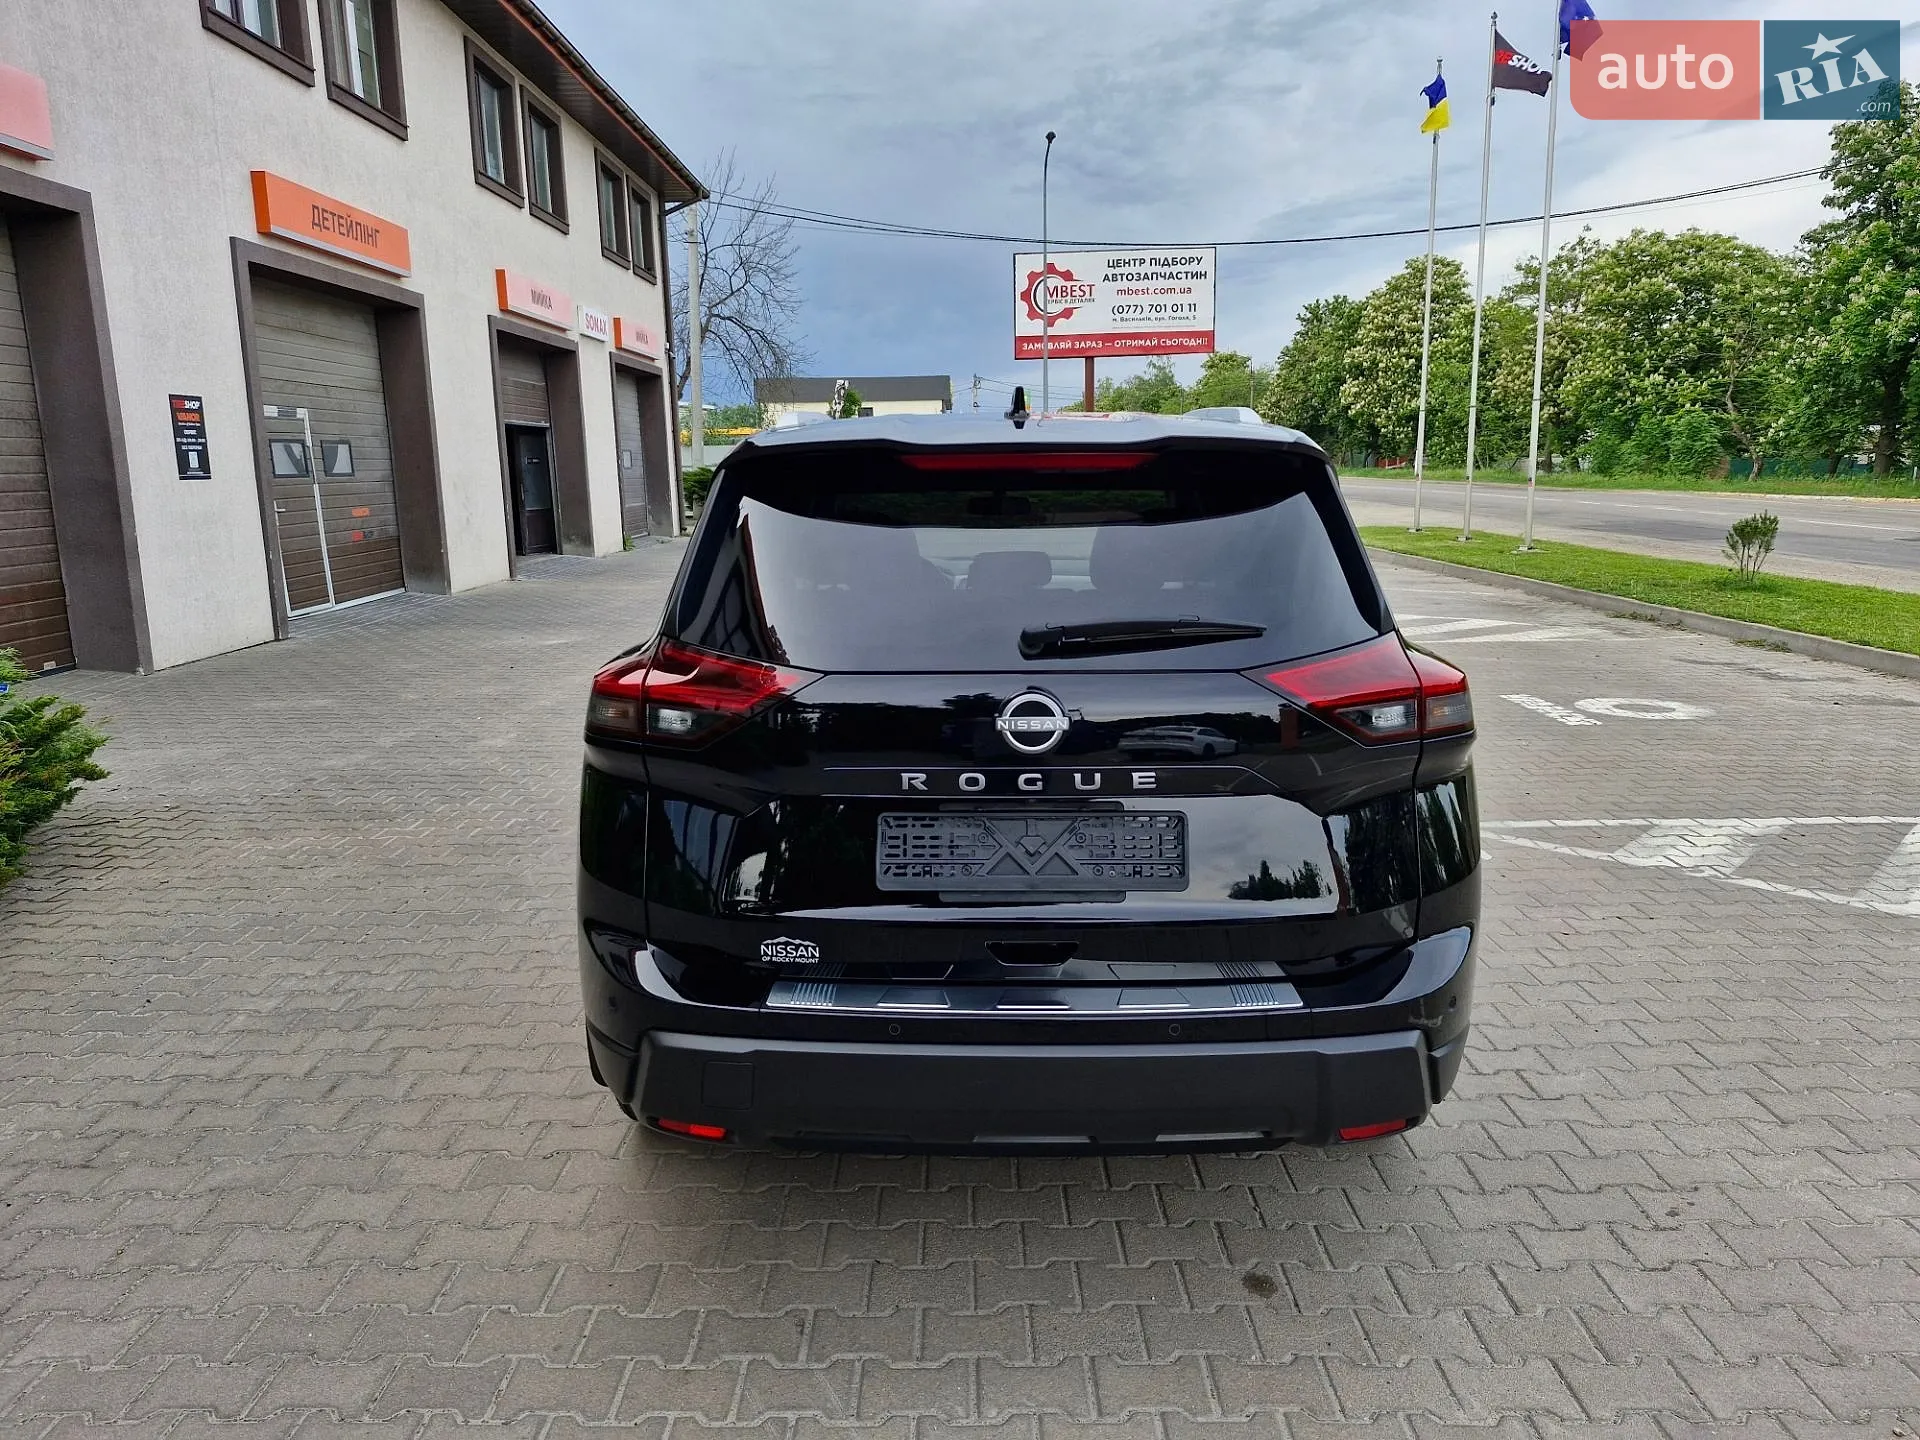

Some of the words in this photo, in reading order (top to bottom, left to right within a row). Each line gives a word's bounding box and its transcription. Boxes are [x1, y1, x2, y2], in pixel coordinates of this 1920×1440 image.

[311, 203, 380, 249] ДЕТЕЙЛІНГ
[1107, 258, 1146, 269] ЦЕНТР
[1149, 256, 1203, 268] ПІДБОРУ
[1102, 270, 1208, 282] АВТОЗАПЧАСТИН
[1116, 286, 1192, 297] mbest.com.ua
[1111, 304, 1144, 315] (077)
[1148, 303, 1167, 313] 701
[1171, 303, 1184, 313] 01
[1188, 303, 1197, 312] 11
[585, 312, 608, 336] SONAX
[1074, 340, 1103, 349] ЗАРАЗ
[1114, 338, 1158, 347] ОТРИМАЙ
[1160, 337, 1208, 346] СЬОГОДНІ!
[997, 719, 1069, 730] NISSAN
[900, 772, 1157, 791] ROGUE
[760, 944, 820, 958] NISSAN
